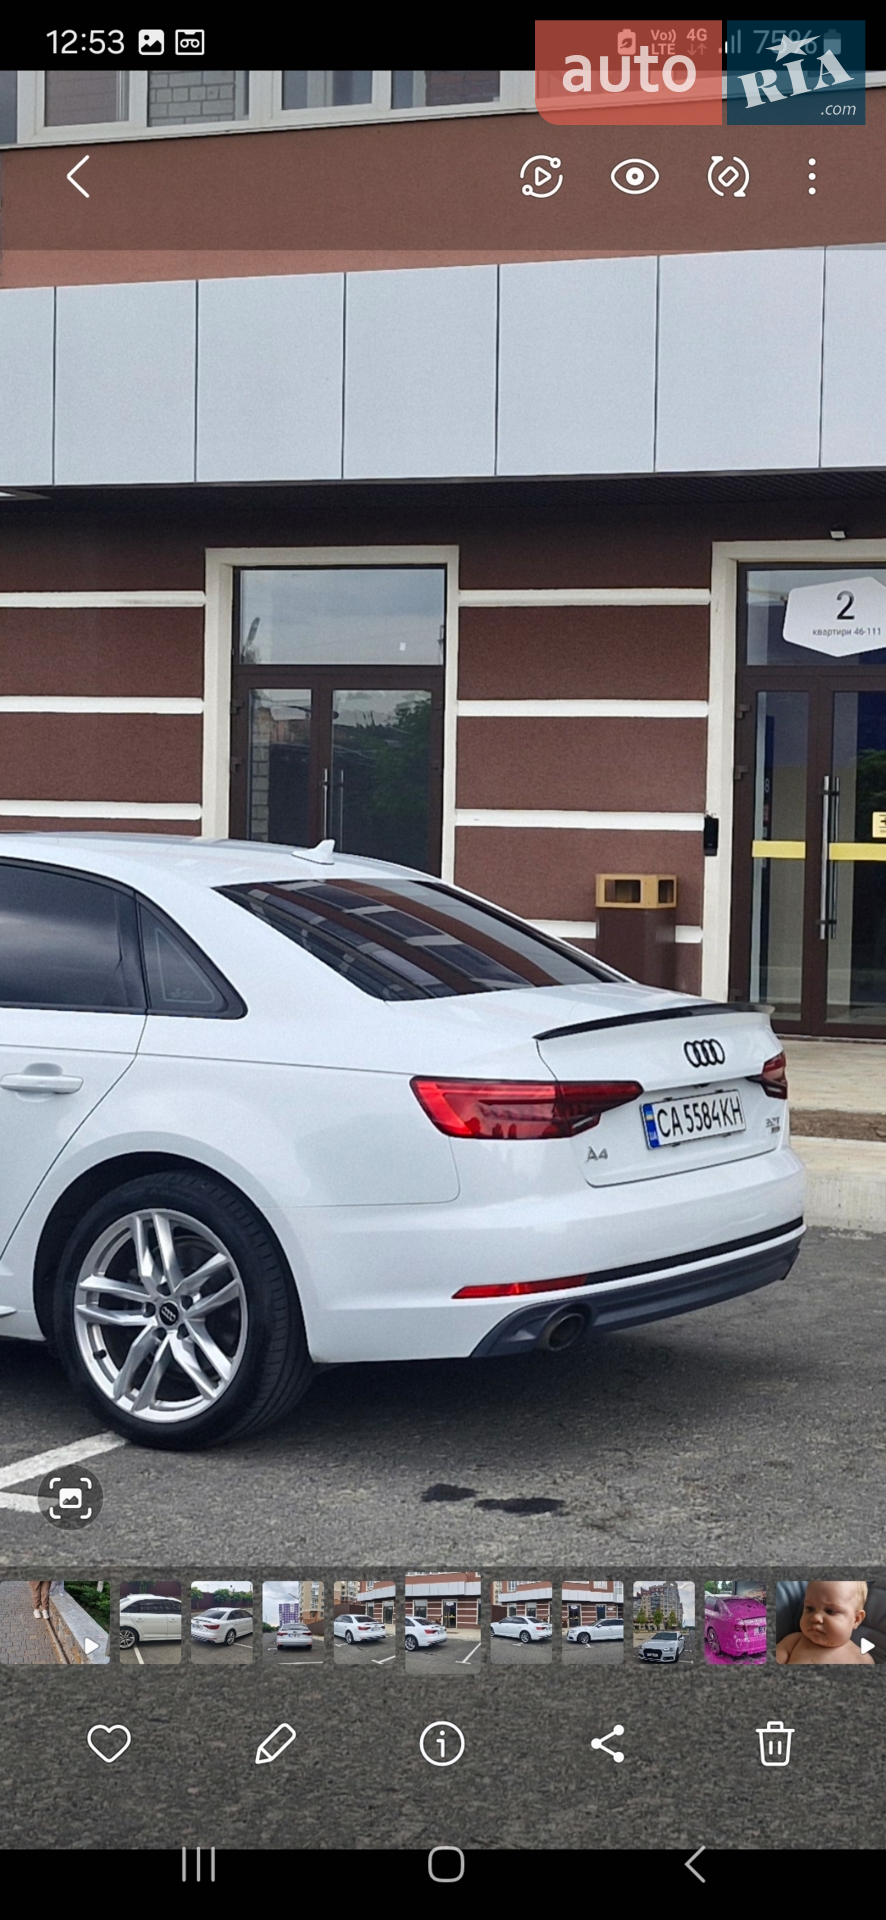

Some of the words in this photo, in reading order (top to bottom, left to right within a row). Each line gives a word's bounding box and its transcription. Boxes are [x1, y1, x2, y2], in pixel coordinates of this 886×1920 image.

[836, 590, 855, 620] 2
[812, 628, 852, 637] квартири
[853, 627, 881, 636] 46-111
[585, 1146, 608, 1163] A4
